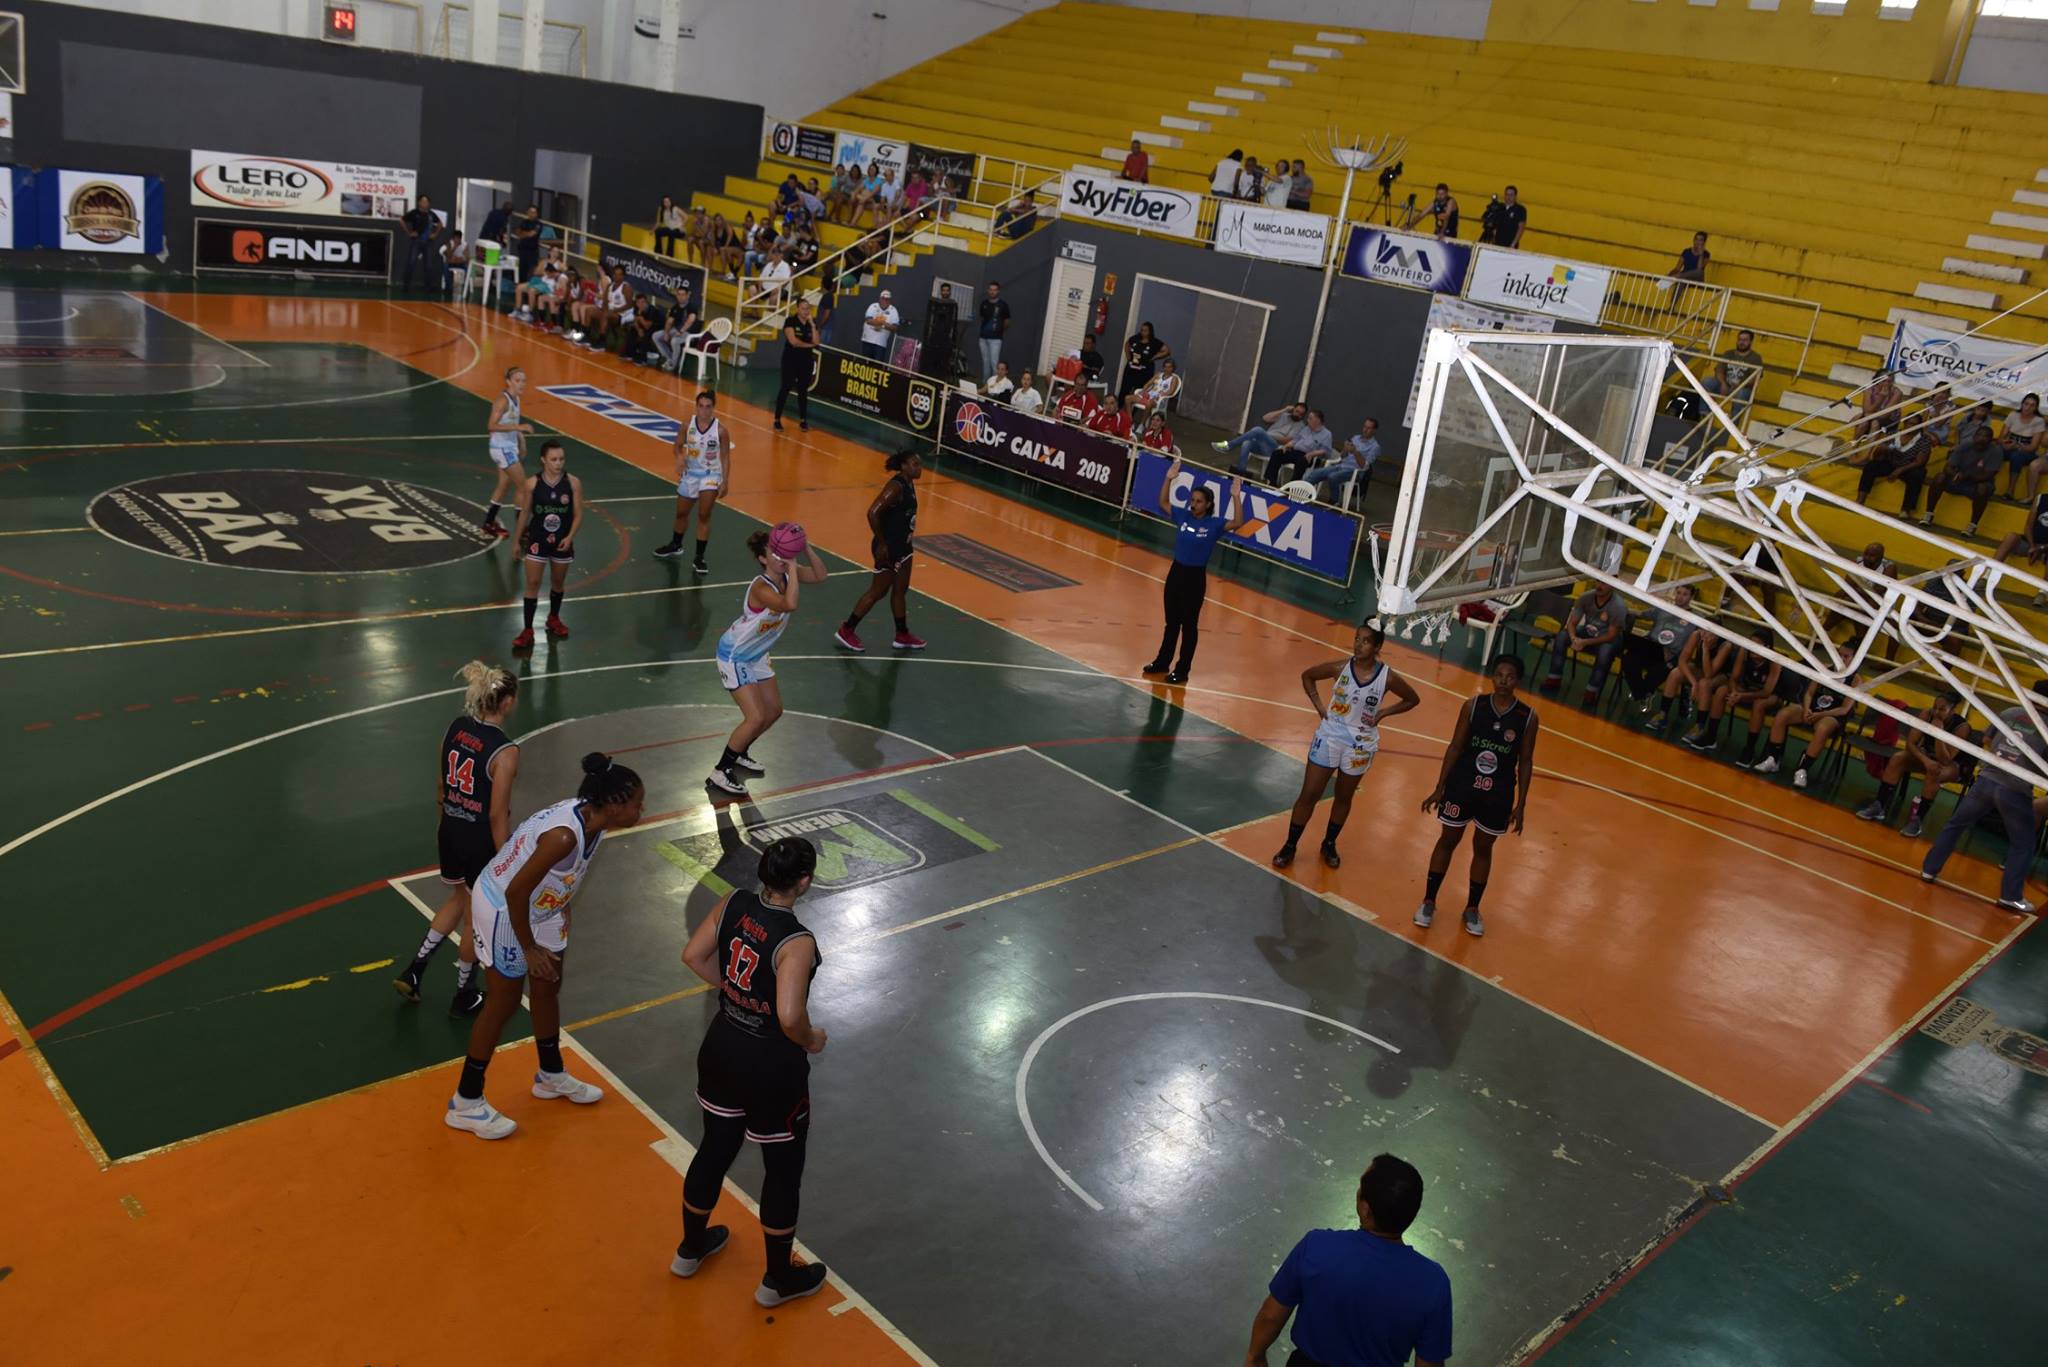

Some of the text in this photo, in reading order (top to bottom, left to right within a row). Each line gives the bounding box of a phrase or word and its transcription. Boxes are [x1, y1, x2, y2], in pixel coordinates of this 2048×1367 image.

[334, 11, 354, 29] 14
[218, 165, 308, 189] LERO
[225, 184, 251, 195] Tudo
[266, 189, 281, 197] seu
[284, 189, 302, 199] Lar
[1068, 179, 1176, 222] SkyFiber
[1253, 221, 1323, 239] MARCA DA MODA
[267, 236, 362, 264] AND1
[1371, 263, 1433, 284] MONTEIRO
[1502, 271, 1569, 309] inkajet
[840, 358, 891, 388] BASQUETE
[846, 378, 880, 402] BRASIL
[1010, 435, 1066, 471] CAIXA
[1076, 457, 1112, 486] 2018
[158, 491, 302, 555] BAX
[308, 485, 453, 543] BAX
[446, 749, 475, 795] 14
[1443, 801, 1460, 818] 10
[751, 811, 849, 843] MERLIM
[726, 936, 760, 992] 17
